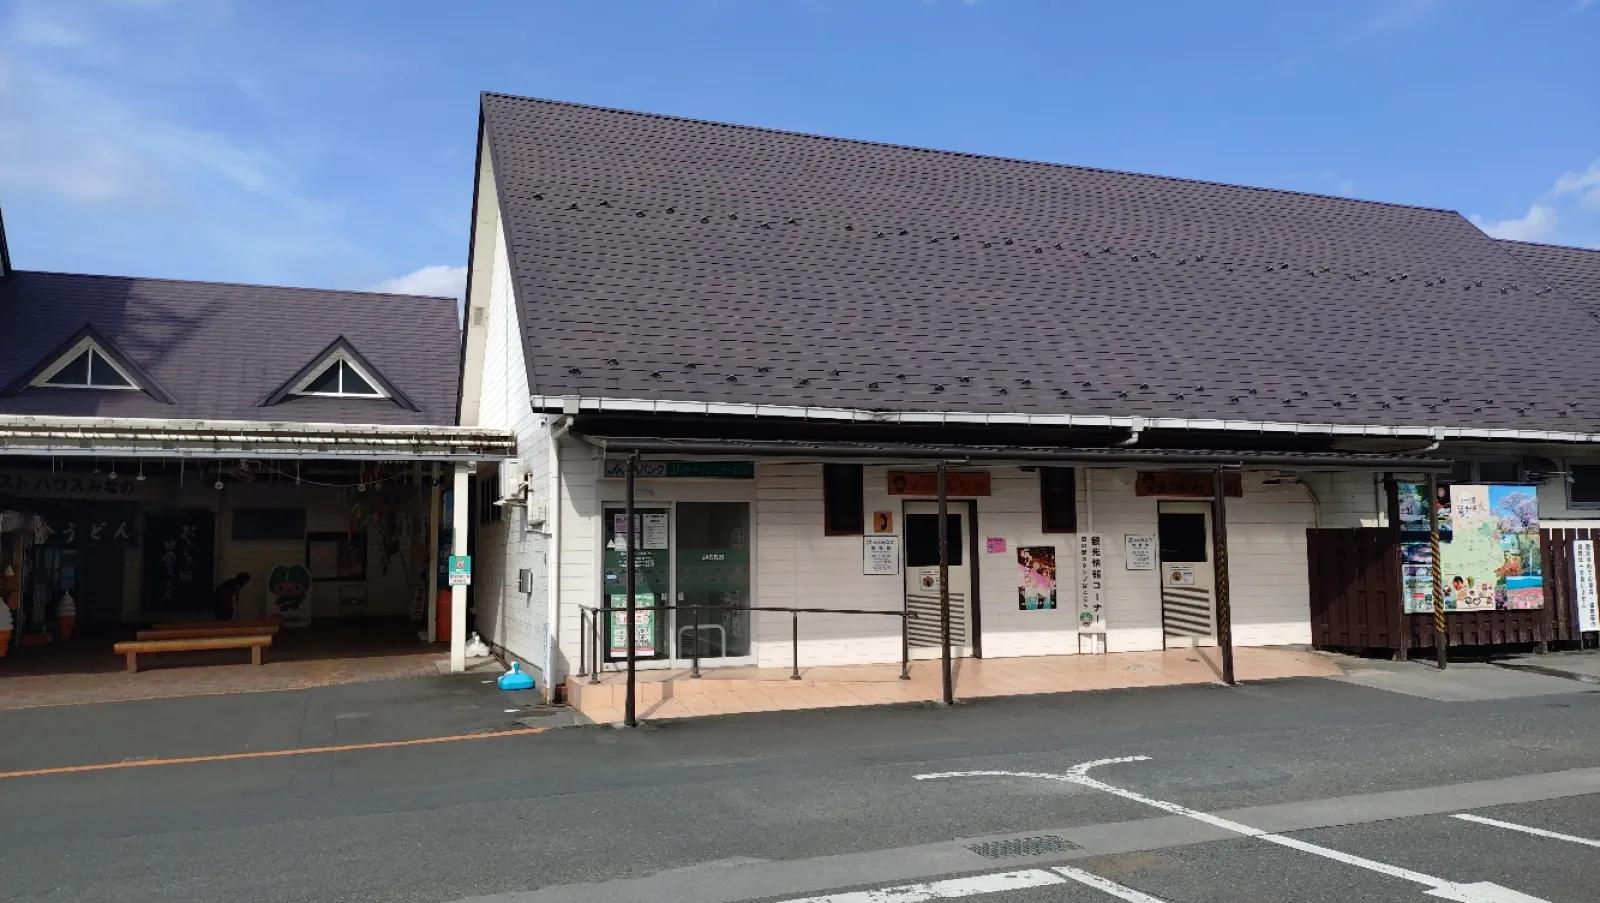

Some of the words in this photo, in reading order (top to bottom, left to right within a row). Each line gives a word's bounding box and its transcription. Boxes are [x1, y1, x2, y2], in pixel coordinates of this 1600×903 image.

[627, 464, 664, 475] Aバンク
[1091, 536, 1102, 624] 観光情報コーナー
